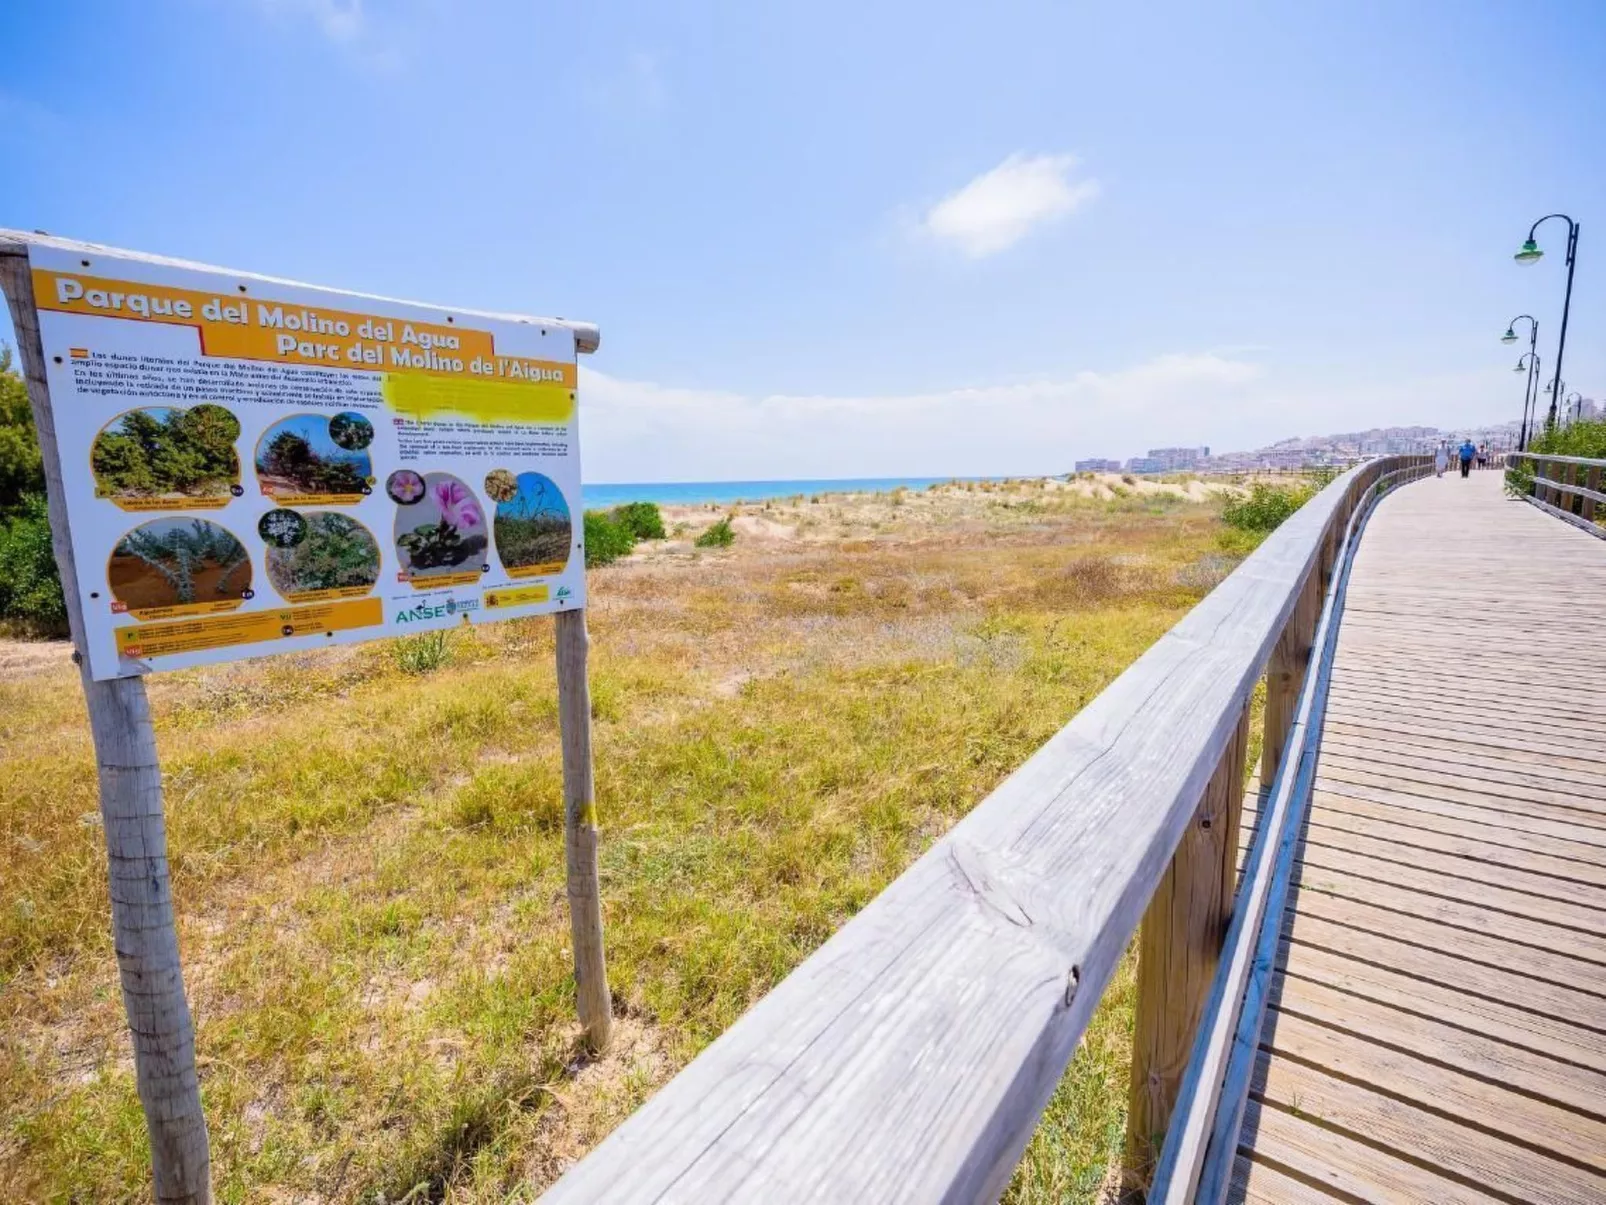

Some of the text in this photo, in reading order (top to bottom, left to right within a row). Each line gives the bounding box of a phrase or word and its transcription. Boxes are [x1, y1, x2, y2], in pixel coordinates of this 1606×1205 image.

[54, 277, 460, 350] Parque del Molino del Agua
[275, 333, 564, 383] Parc del Molino de l'Aigua
[395, 604, 445, 624] ANSE
